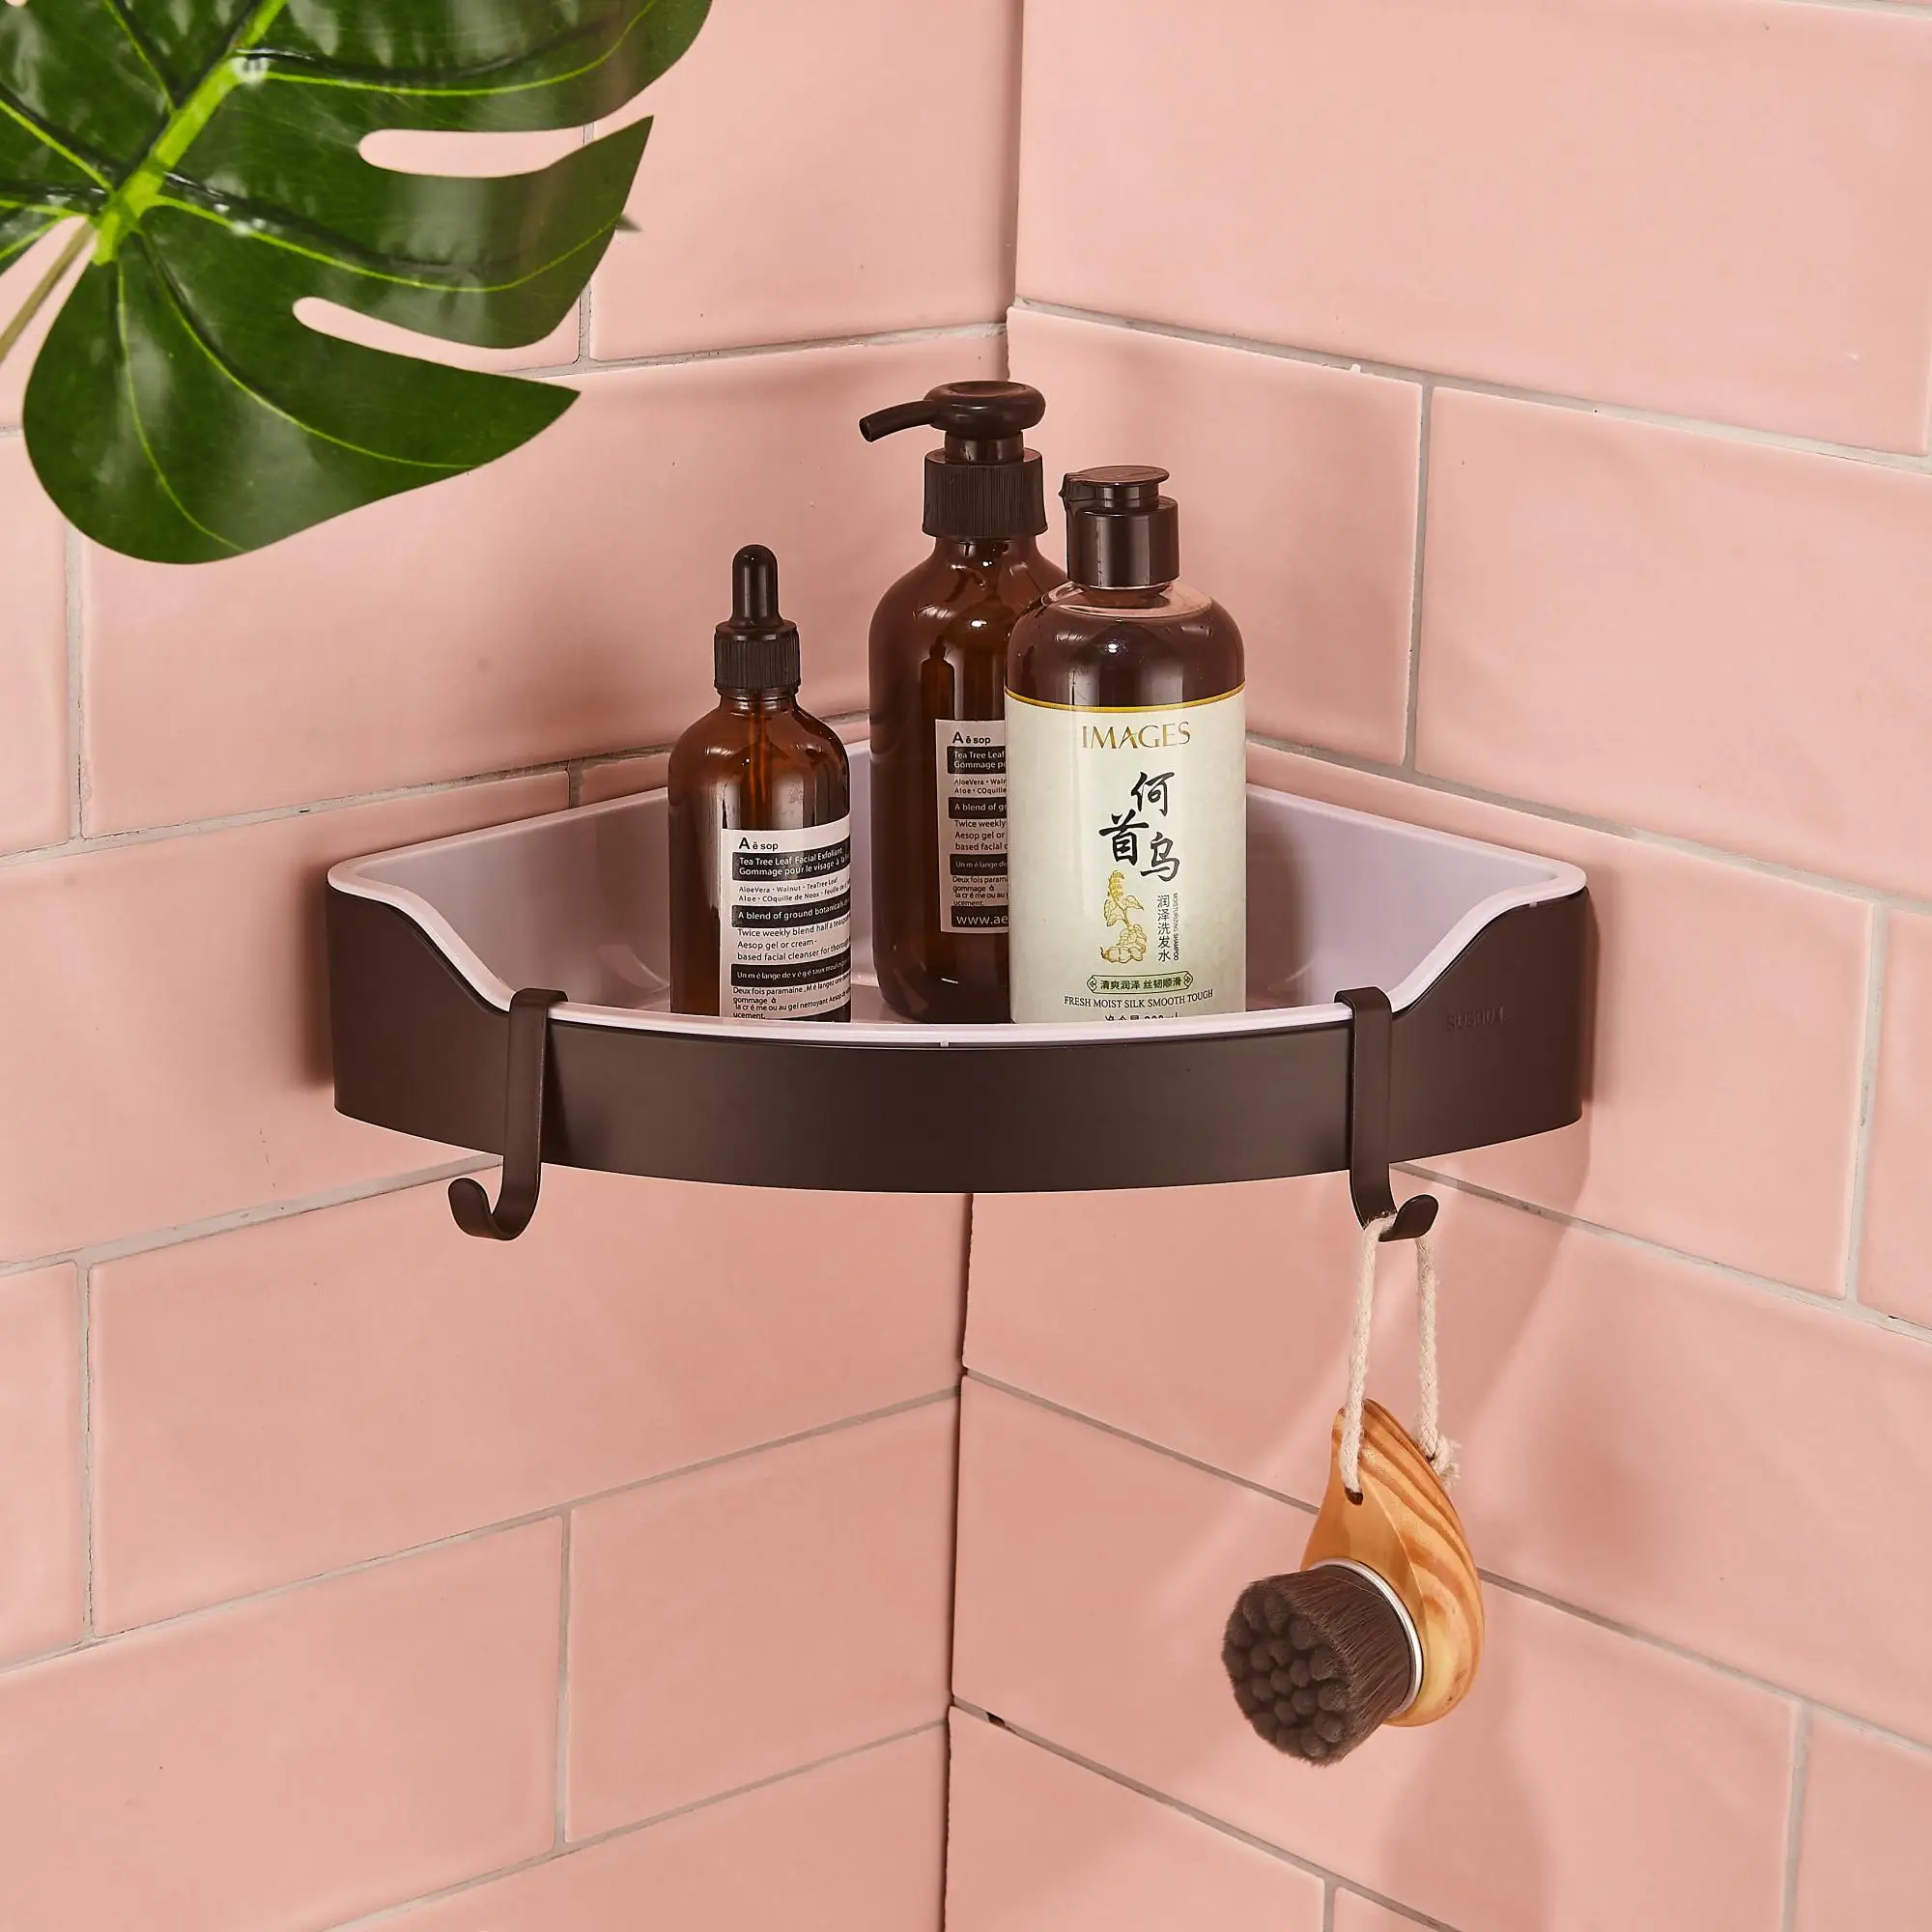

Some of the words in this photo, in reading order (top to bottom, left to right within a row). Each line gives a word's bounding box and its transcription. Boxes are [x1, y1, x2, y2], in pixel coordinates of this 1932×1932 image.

[1081, 721, 1191, 749] IMAGES
[953, 760, 996, 770] Gommage
[979, 819, 1006, 829] weekly
[981, 832, 994, 840] gel
[739, 857, 753, 866] Tea
[775, 856, 792, 866] Leaf
[795, 853, 816, 864] Facial
[817, 847, 842, 860] Exfoliant
[739, 867, 782, 877] Gommage
[784, 867, 804, 876] pour
[806, 864, 812, 872] le
[813, 861, 834, 871] visage
[807, 881, 827, 890] TeaTree
[747, 911, 771, 920] blend
[773, 911, 782, 920] of
[784, 909, 812, 921] ground
[737, 928, 760, 937] Twice
[762, 928, 791, 938] weekly
[792, 924, 814, 935] blend
[816, 921, 829, 931] half
[1157, 895, 1171, 962] 润泽洗发水
[737, 941, 763, 950] Aesop
[765, 941, 779, 951] gel
[737, 952, 762, 961] based
[764, 952, 786, 961] facial
[787, 950, 820, 960] cleanser
[820, 946, 830, 955] for
[1100, 980, 1141, 990] 清爽润泽
[788, 1003, 799, 1011] gel
[800, 998, 828, 1009] nettoyant
[1064, 995, 1091, 1008] FRESH
[1094, 999, 1122, 1008] MOIST
[1124, 999, 1146, 1008] SILK
[1148, 996, 1185, 1008] SMOOTH
[1187, 988, 1213, 1003] TOUGH
